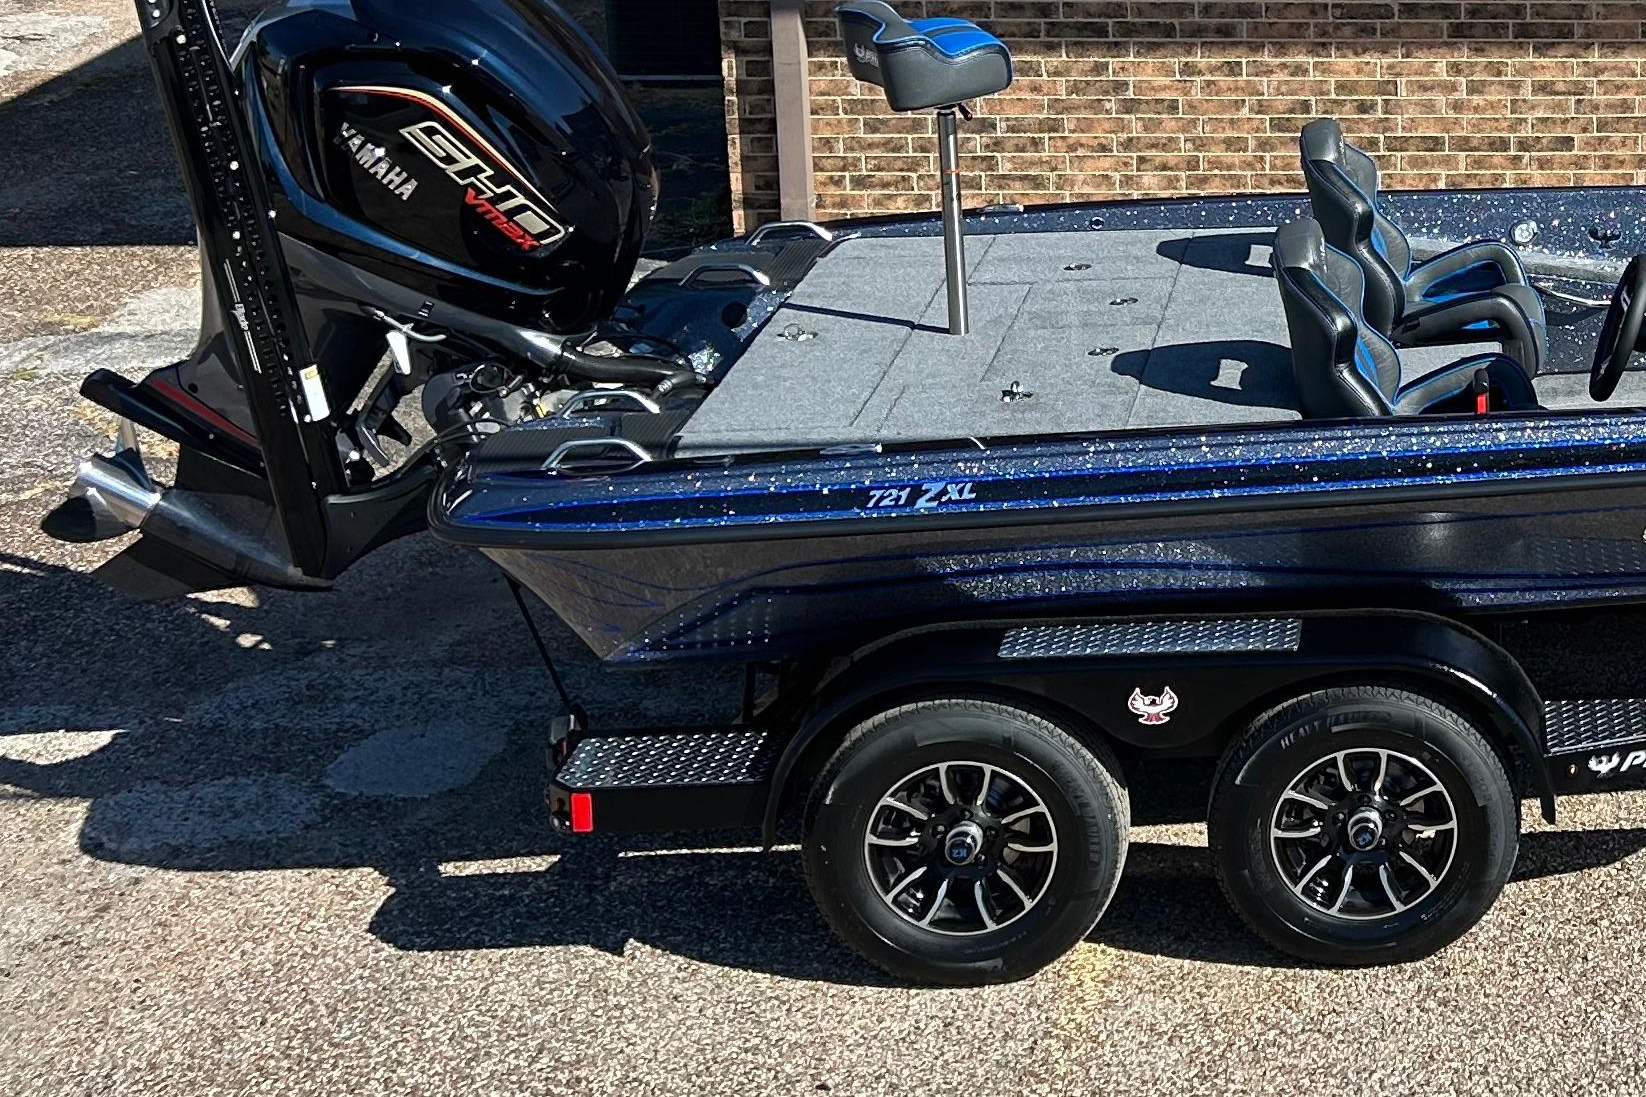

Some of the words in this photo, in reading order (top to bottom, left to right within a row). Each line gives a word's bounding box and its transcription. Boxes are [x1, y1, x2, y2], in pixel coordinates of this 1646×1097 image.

[336, 121, 419, 201] YAMAHA
[398, 121, 565, 245] SHO
[866, 487, 911, 508] 721
